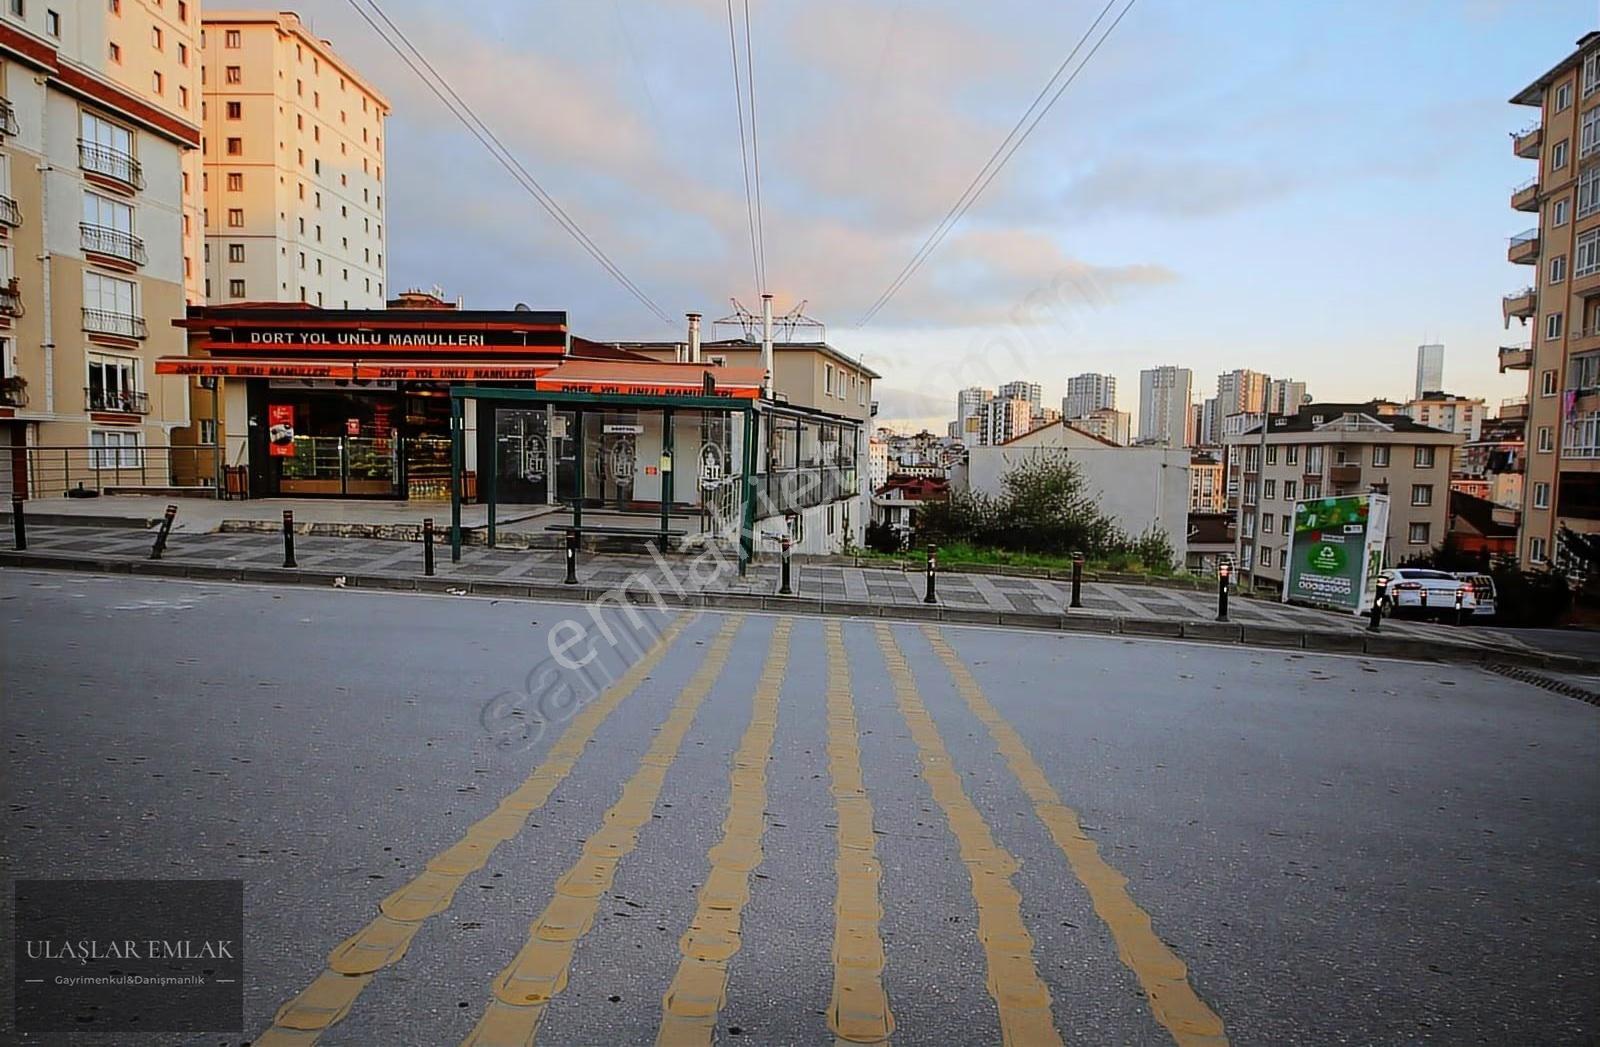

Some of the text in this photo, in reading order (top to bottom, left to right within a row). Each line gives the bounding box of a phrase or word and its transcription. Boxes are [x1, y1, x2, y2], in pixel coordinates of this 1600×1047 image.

[299, 333, 330, 344] YOL
[338, 333, 381, 345] UNLU
[211, 366, 229, 375] YOL
[415, 368, 433, 378] YOL
[440, 368, 468, 378] UNLU
